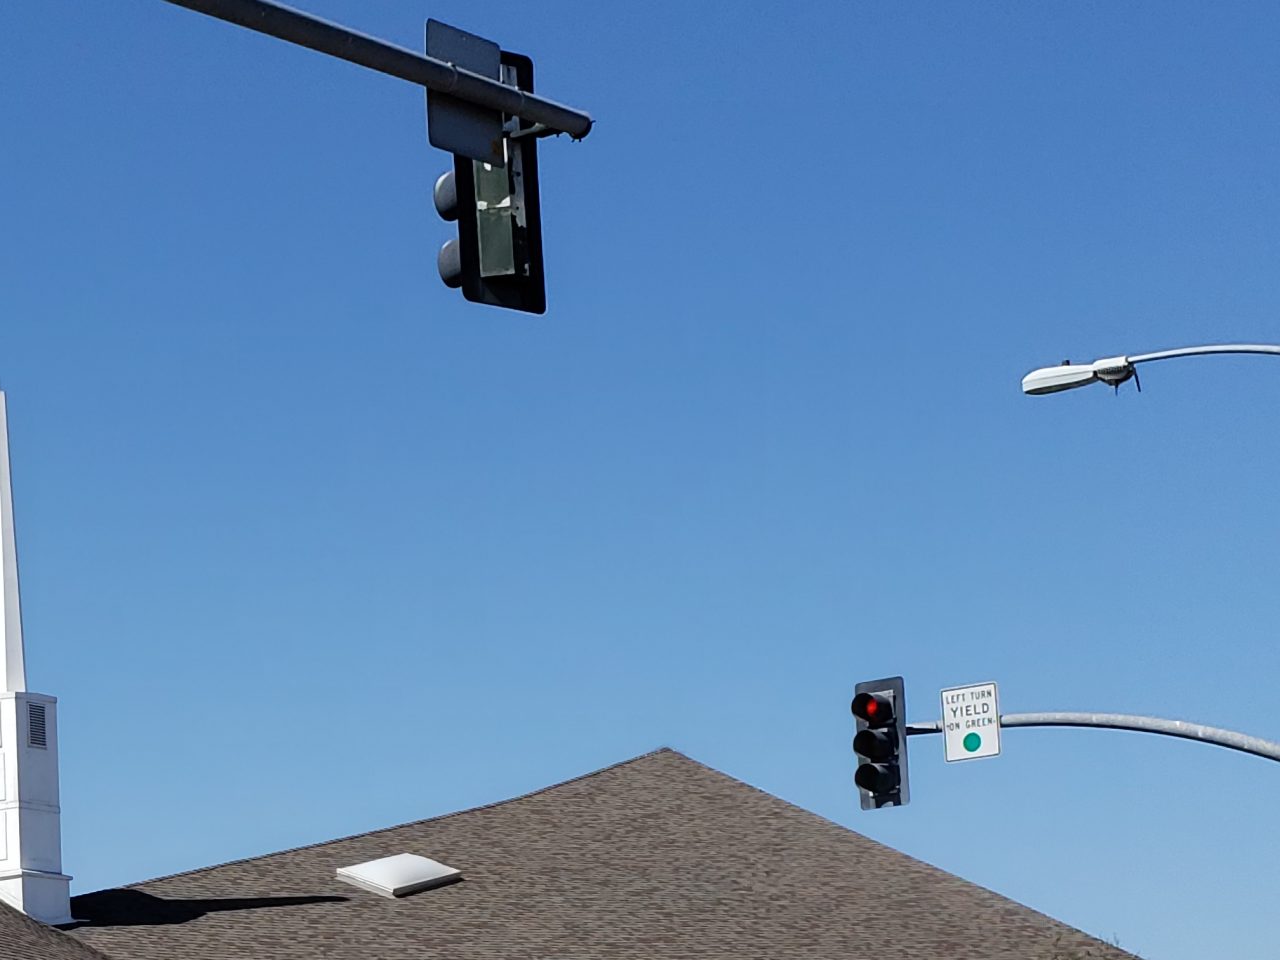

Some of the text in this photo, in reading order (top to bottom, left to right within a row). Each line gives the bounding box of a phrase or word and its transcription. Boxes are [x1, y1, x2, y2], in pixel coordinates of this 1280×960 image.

[946, 689, 992, 704] LEFT TURN
[951, 703, 989, 718] YIELD
[966, 717, 992, 728] GREEN
